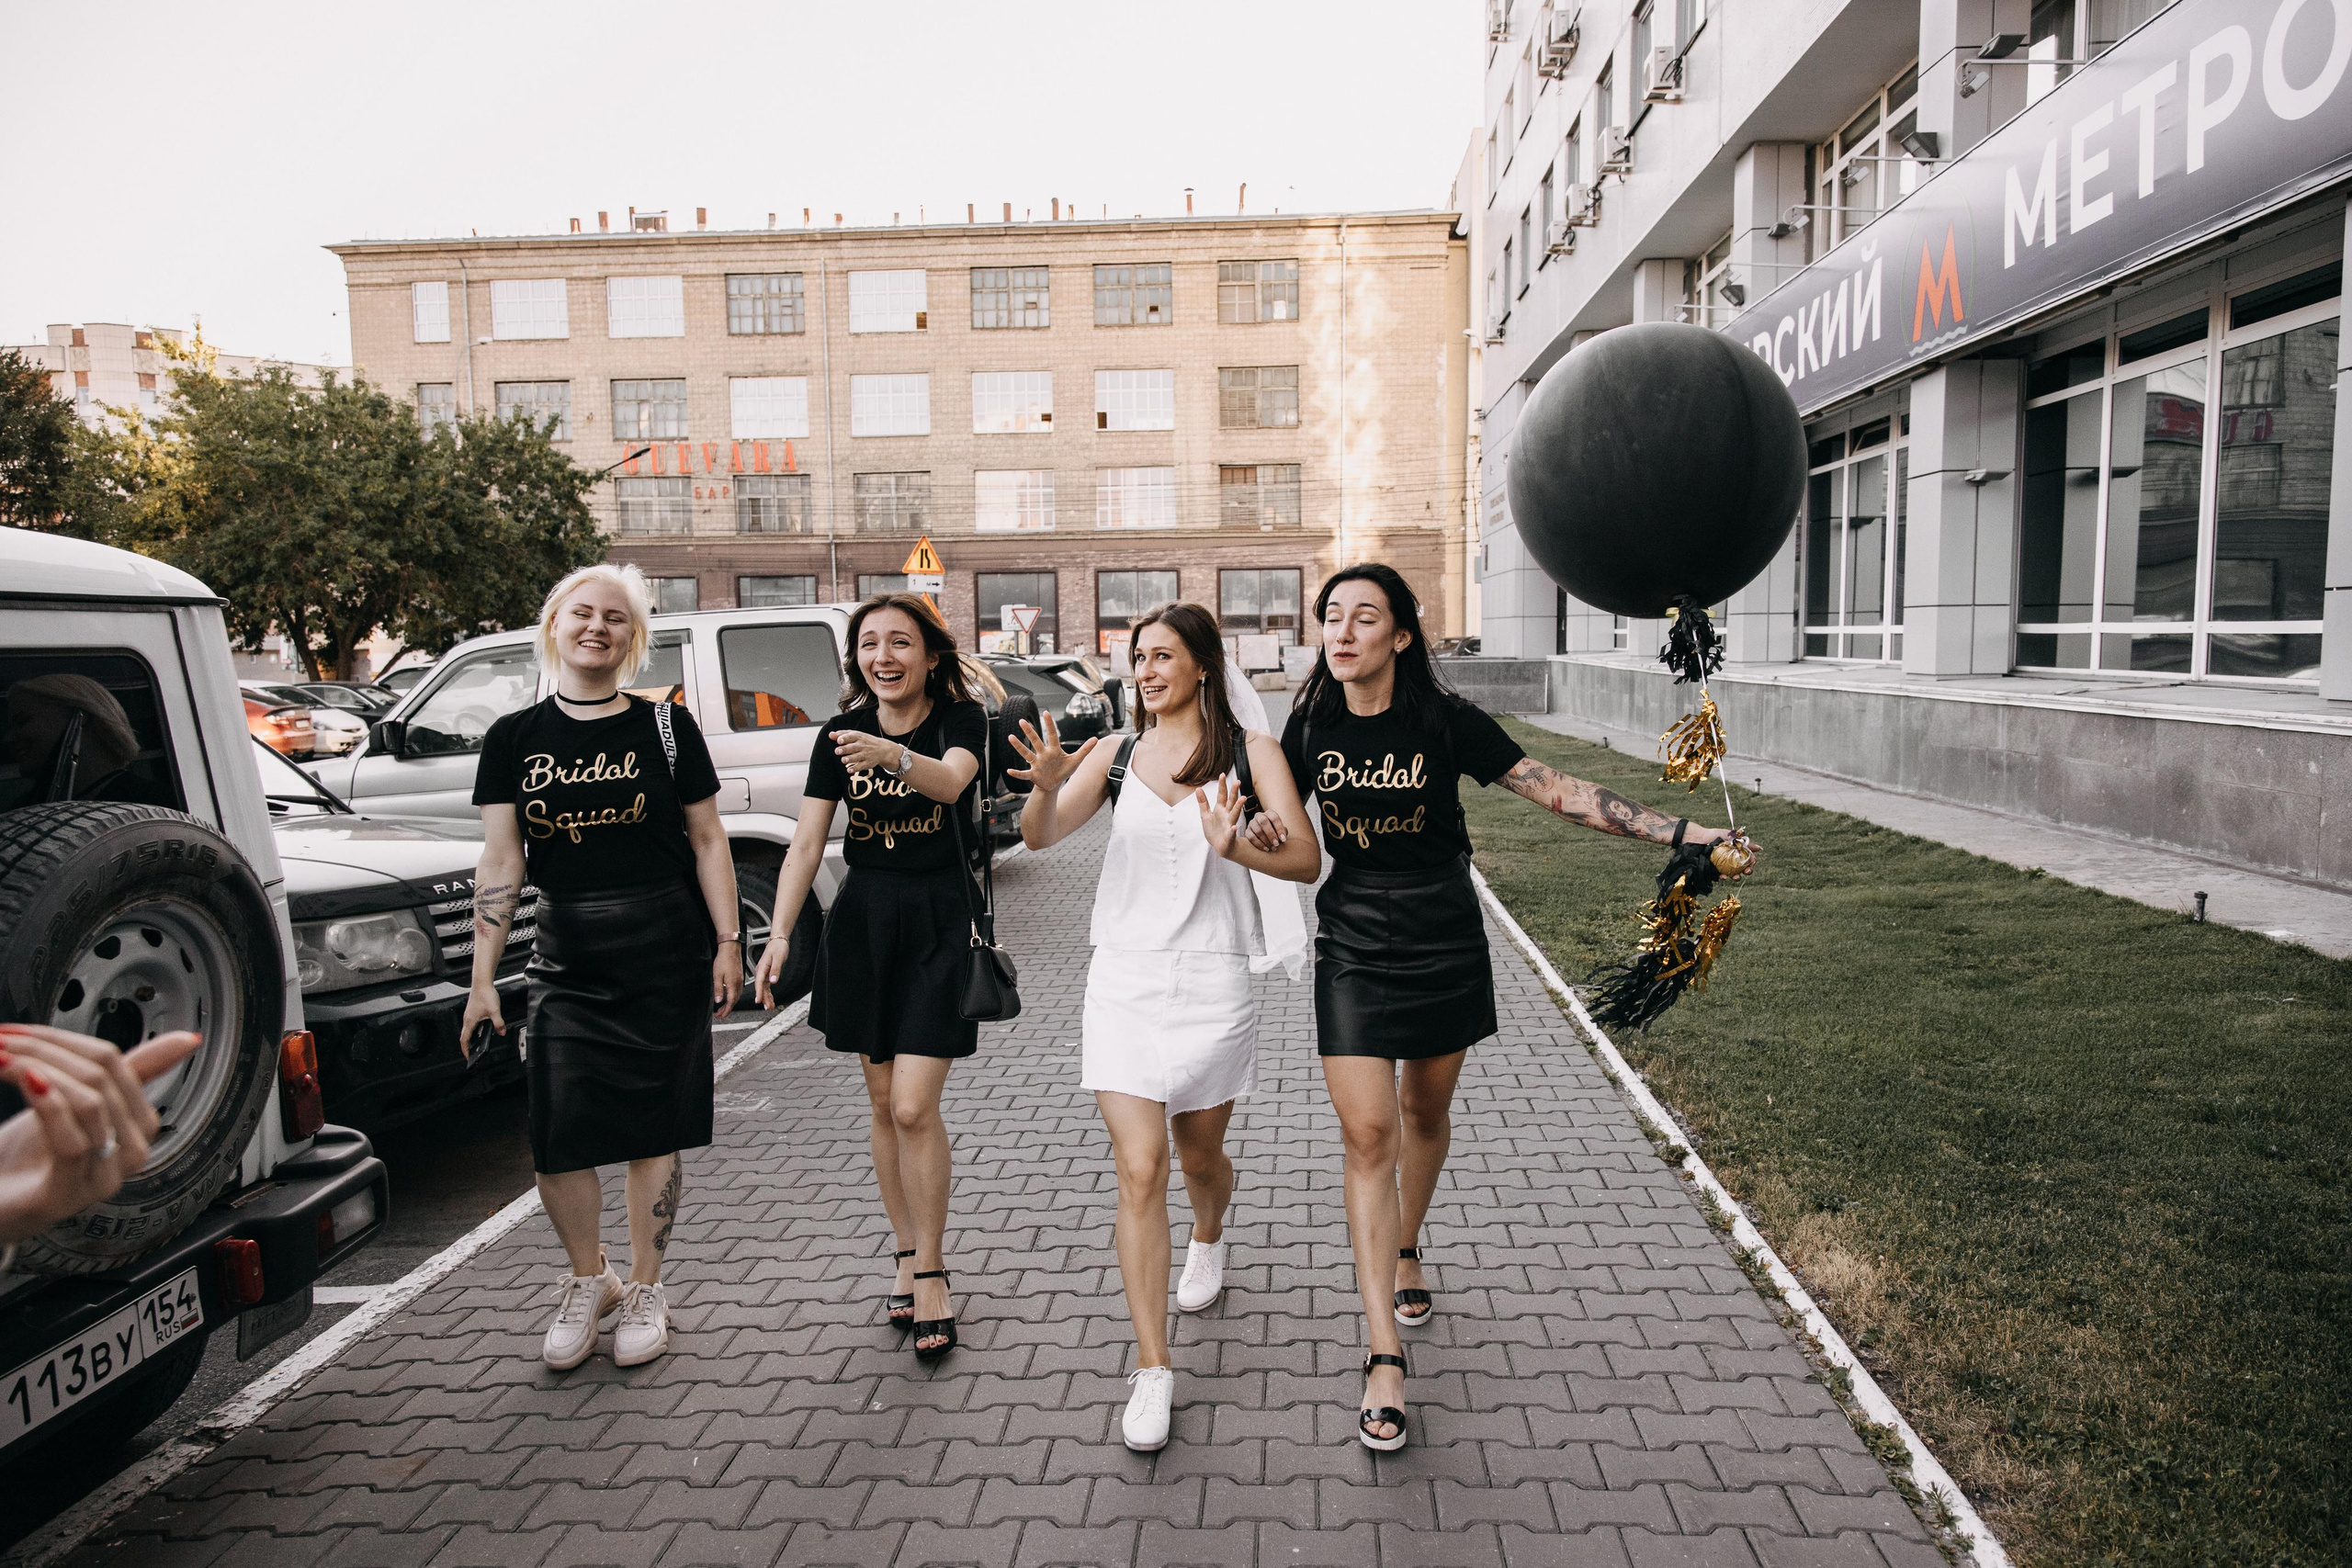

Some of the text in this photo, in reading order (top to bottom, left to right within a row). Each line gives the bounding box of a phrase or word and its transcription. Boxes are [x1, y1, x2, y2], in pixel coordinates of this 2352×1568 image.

[623, 440, 797, 475] GUEVARA
[694, 486, 729, 500] БАР
[522, 751, 639, 793] Bridal
[1317, 750, 1427, 792] Bridal
[525, 793, 647, 844] Squad
[849, 804, 944, 850] Squad
[1322, 801, 1425, 850] Squad
[143, 1279, 192, 1333] 154
[156, 1320, 181, 1345] RUS
